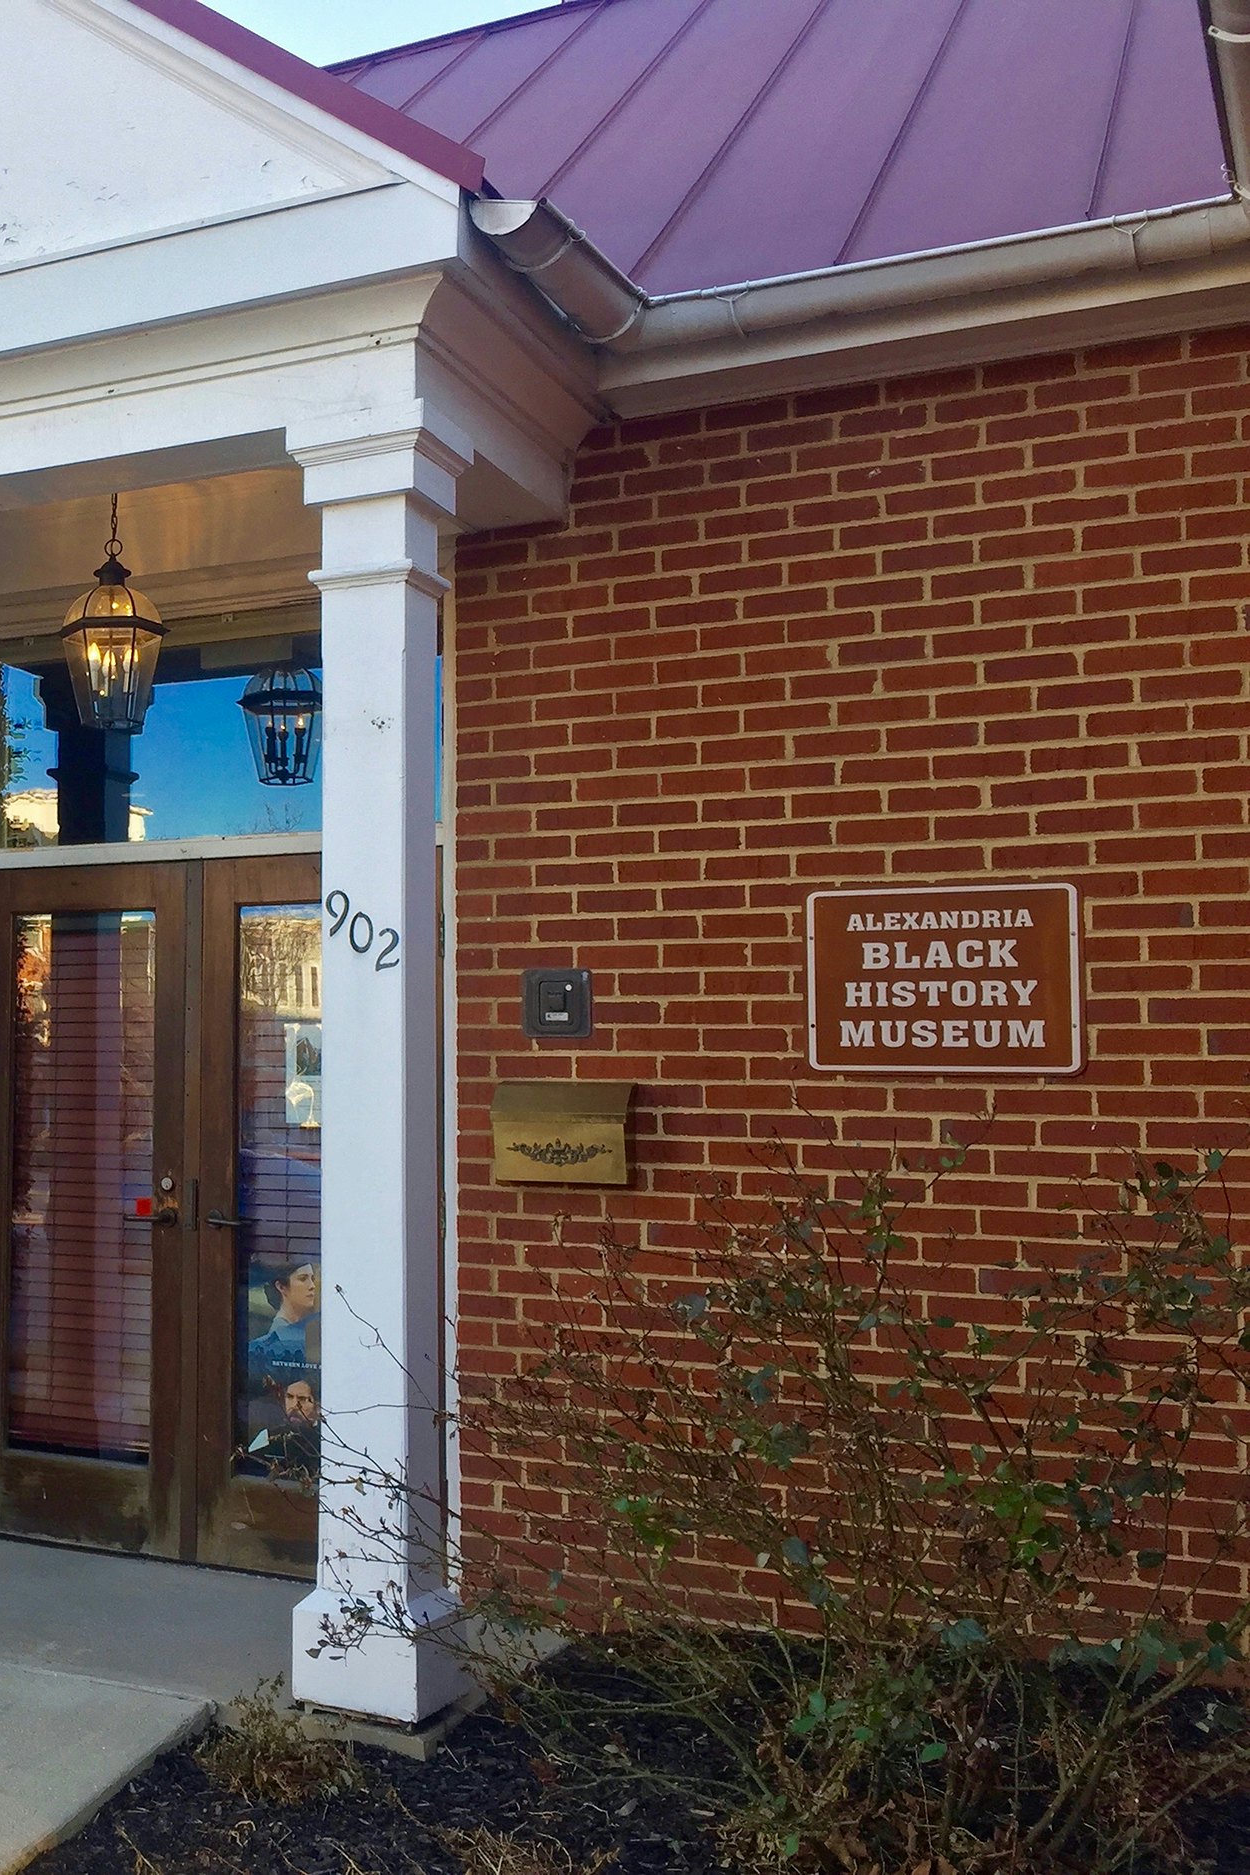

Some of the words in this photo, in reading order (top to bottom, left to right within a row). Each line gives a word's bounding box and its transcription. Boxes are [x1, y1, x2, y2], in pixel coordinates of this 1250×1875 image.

[325, 890, 399, 972] 902
[846, 909, 1034, 931] ALEXANDRIA
[862, 939, 1018, 970] BLACK
[845, 980, 1038, 1008] HISTORY
[840, 1020, 1046, 1048] MUSEUM
